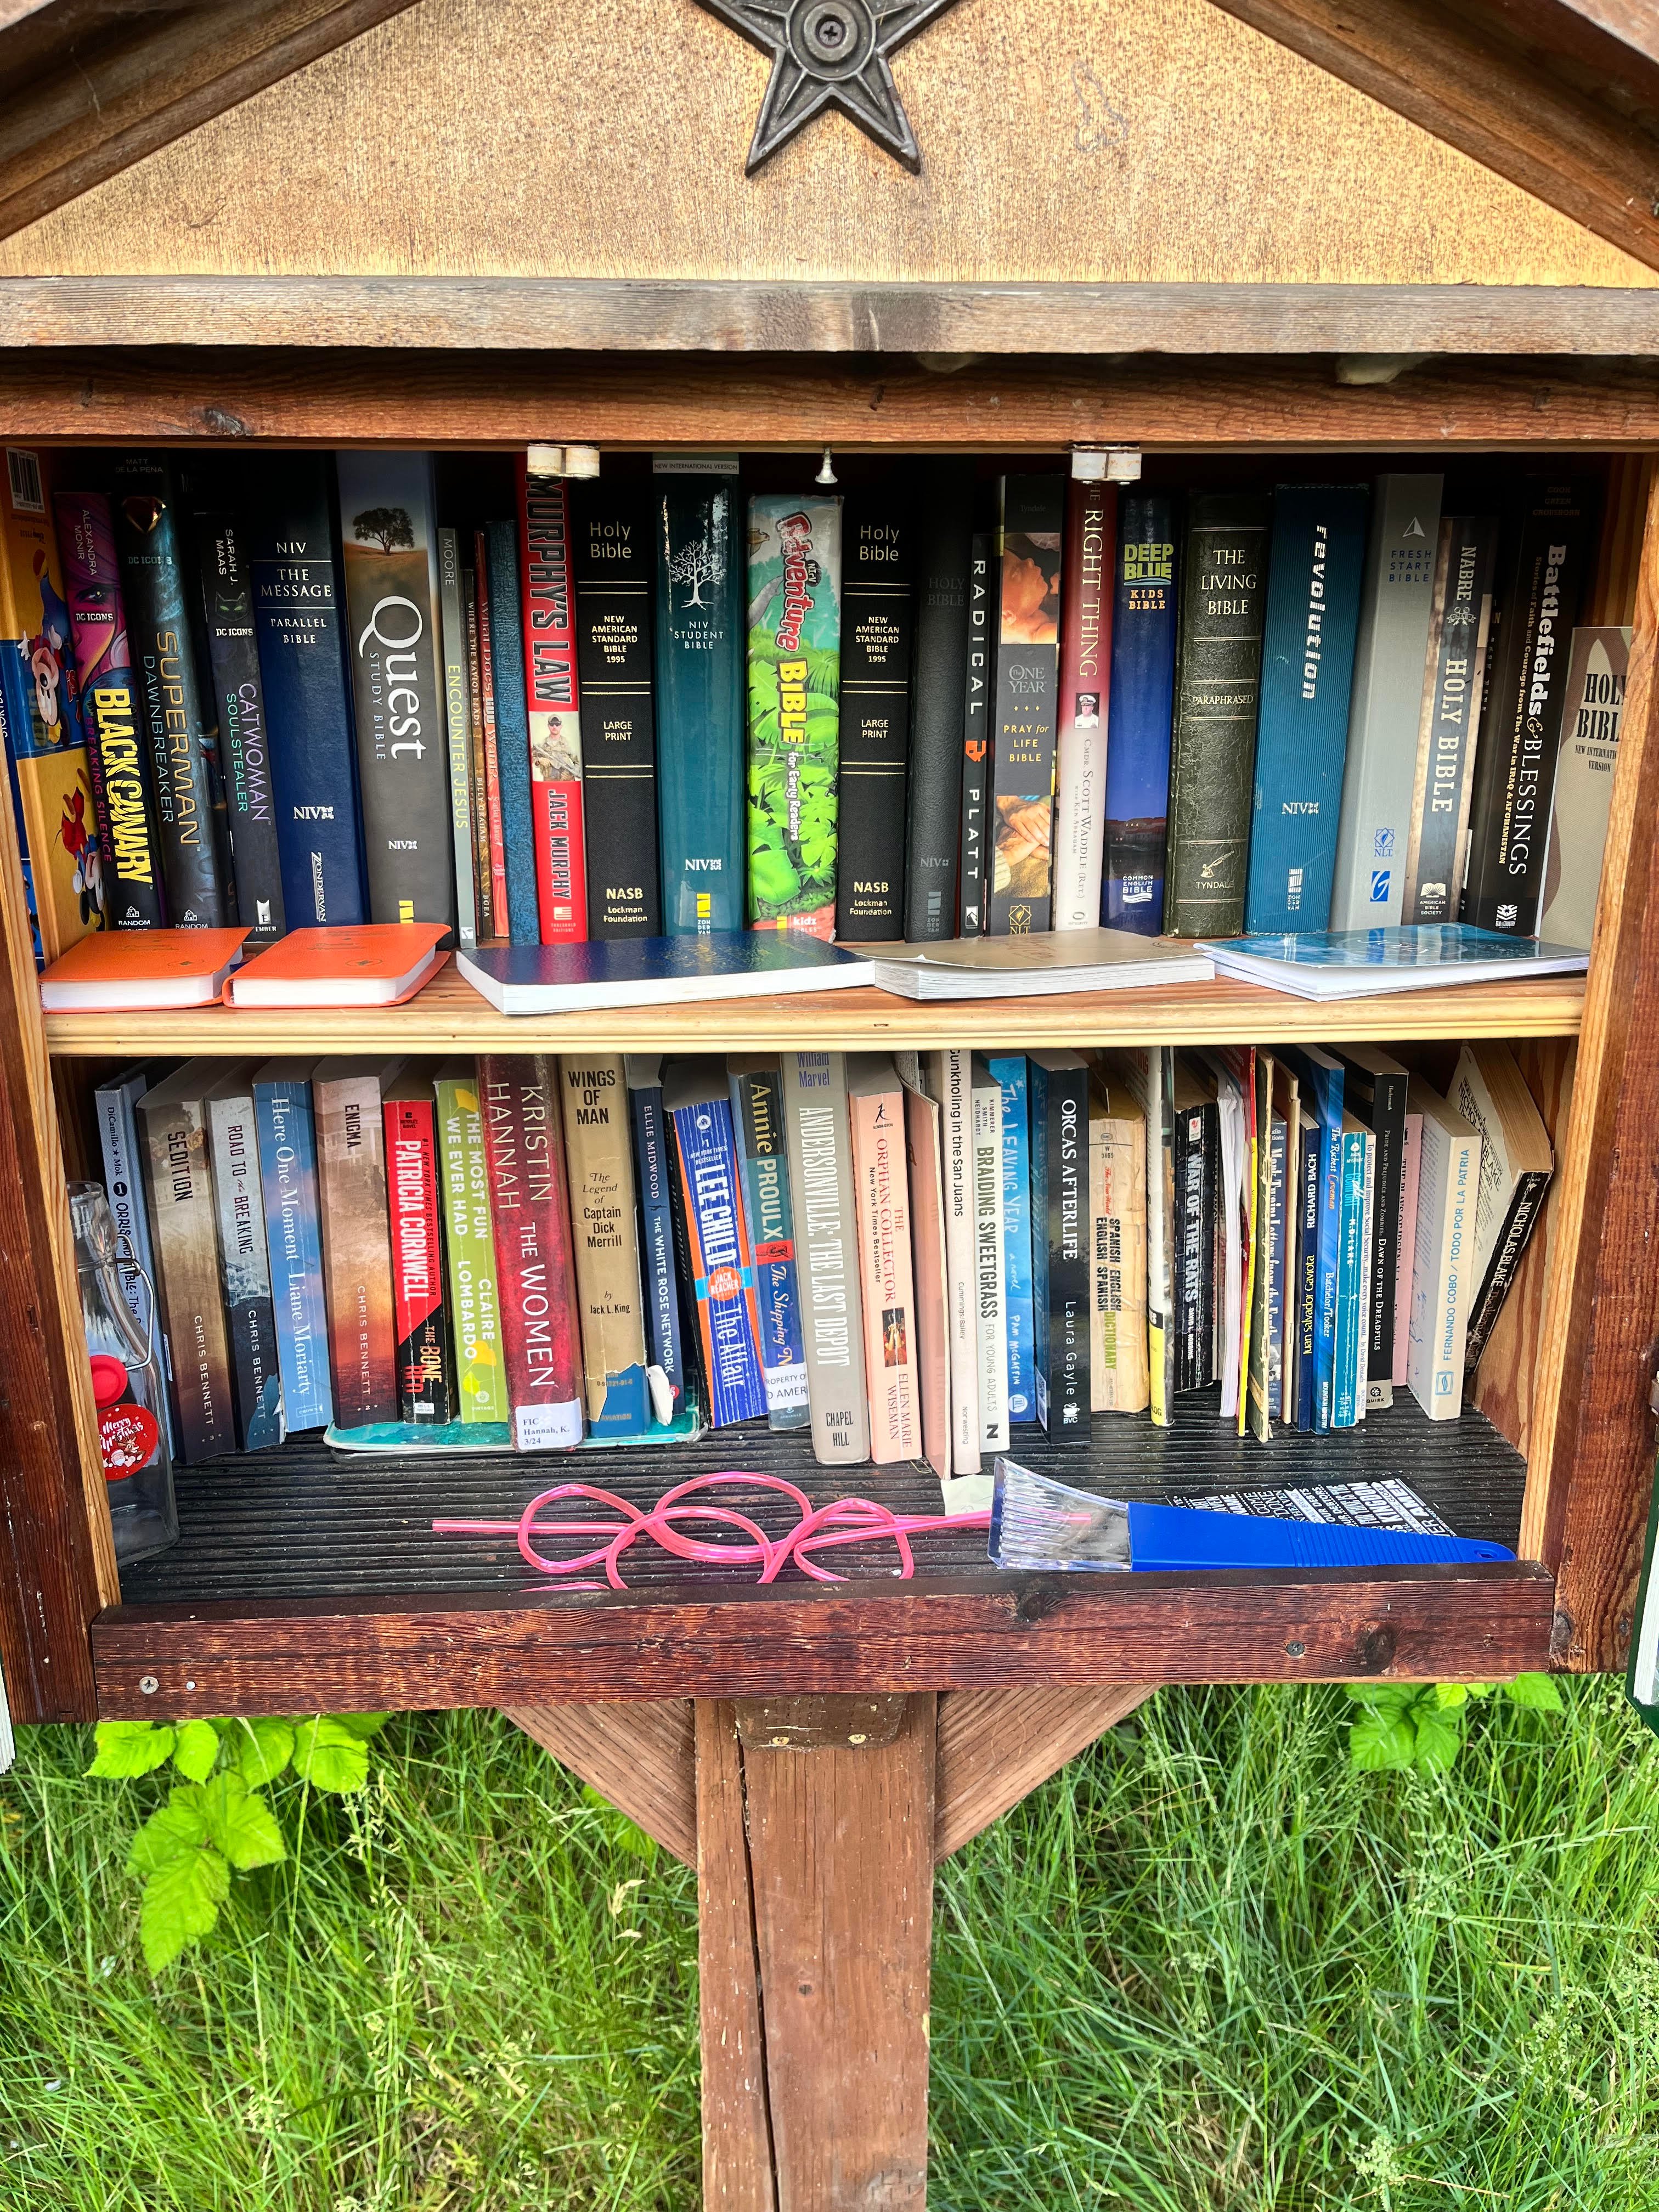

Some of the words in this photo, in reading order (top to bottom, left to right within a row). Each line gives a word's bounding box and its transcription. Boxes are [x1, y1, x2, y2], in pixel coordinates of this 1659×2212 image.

[75, 525, 84, 560] MONIR
[82, 509, 97, 575] ALEXANDRA
[216, 540, 227, 574] MAAS
[225, 529, 236, 573] SARAH
[444, 539, 454, 585] MOORE
[526, 474, 568, 629] MURPHY'S
[1082, 509, 1103, 590] RIGHT
[1125, 544, 1173, 562] DEEP
[1391, 550, 1431, 558] FRESH
[230, 576, 238, 585] J.
[261, 585, 331, 597] MESSAGE
[1124, 563, 1171, 580] BLUE
[1201, 574, 1256, 590] LIVING
[1457, 546, 1477, 601] NABRE
[1131, 590, 1163, 598] KIDS
[1303, 525, 1328, 699] revolution
[271, 618, 327, 628] PARALLEL
[970, 560, 985, 715] RADICAL
[1080, 598, 1100, 677] THING
[1528, 545, 1566, 715] Battlefields
[359, 596, 426, 759] Quest
[370, 652, 382, 706] STUDY
[533, 641, 572, 703] LAW
[1441, 659, 1468, 724] HOLY
[448, 665, 465, 772] ENCOUNTER
[1193, 695, 1253, 705] PARAPHRASED
[95, 689, 140, 777] BLACK
[144, 656, 173, 822] DAWNBREAKER
[157, 633, 200, 845] SUPERMAN
[374, 715, 386, 759] BIBLE
[603, 721, 632, 730] LARGE
[605, 732, 631, 741] PRINT
[1526, 718, 1543, 738] &
[227, 694, 248, 812] SOULSTEALER
[239, 684, 270, 821] CATWOMAN
[1432, 736, 1458, 812] BIBLE
[85, 718, 103, 794] BREAKING
[97, 802, 111, 861] SILENCE
[454, 778, 467, 828] JESUS
[549, 789, 568, 831] JACK
[1509, 740, 1542, 875] BLESSINGS
[107, 779, 153, 883] CANARY
[478, 806, 486, 843] GRAHAM
[968, 789, 980, 879] PLATT
[551, 838, 570, 899] MURPHY
[1196, 881, 1234, 889] TYNDALE
[606, 888, 642, 899] NASB
[793, 916, 817, 926] kidz
[568, 1070, 615, 1087] WINGS
[272, 1097, 290, 1142] Here
[345, 1104, 361, 1148] ENIGMA
[447, 1118, 461, 1144] WE
[467, 1112, 480, 1143] THE
[577, 1108, 608, 1125] MAN
[644, 1105, 653, 1137] ELLIE
[750, 1084, 777, 1153] Annie
[1062, 1099, 1076, 1160] ORCAS
[488, 1083, 521, 1209] HANNAH
[521, 1086, 552, 1201] KRISTIN
[168, 1131, 193, 1202] SEDITION
[276, 1147, 294, 1184] One
[395, 1141, 424, 1212] PATRICIA
[450, 1150, 465, 1193] EVER
[469, 1151, 484, 1199] MOST
[647, 1141, 659, 1198] MIDWOOD
[696, 1164, 728, 1206] LEE
[877, 1138, 892, 1204] ORPHAN
[977, 1147, 995, 1216] BRAIDING
[1308, 1153, 1317, 1181] BACH
[1459, 1149, 1469, 1185] PATRIA
[583, 1183, 617, 1194] Legend
[757, 1158, 784, 1241] PROULX
[1307, 1186, 1316, 1228] RICHARD
[1457, 1191, 1465, 1204] LA
[280, 1188, 300, 1261] Moment
[453, 1200, 467, 1235] HAD
[473, 1207, 487, 1238] FUN
[584, 1207, 621, 1221] Captain
[593, 1222, 614, 1234] Dick
[1062, 1165, 1077, 1260] AFTERLIFE
[1454, 1210, 1463, 1229] POR
[1502, 1202, 1532, 1253] NICHOLAS
[520, 1222, 538, 1257] THE
[588, 1235, 622, 1248] Merrill
[655, 1235, 666, 1275] WHITE
[699, 1205, 737, 1265] CHILD
[880, 1210, 896, 1302] COLLECTOR
[1096, 1217, 1107, 1259] ENGLISH
[1109, 1219, 1120, 1262] SPANISH
[1378, 1238, 1386, 1264] DAWN
[1451, 1233, 1462, 1261] TODO
[399, 1217, 430, 1301] CORNWELL
[979, 1222, 998, 1318] SWEETGRASS
[1305, 1255, 1314, 1291] Gaviota
[1378, 1267, 1384, 1277] OF
[1491, 1256, 1510, 1286] BLAKE
[289, 1273, 305, 1321] Liane
[457, 1261, 477, 1359] LOMBARDO
[478, 1279, 494, 1339] CLAIRE
[590, 1305, 605, 1314] Jack
[615, 1304, 630, 1314] King
[658, 1278, 669, 1310] ROSE
[1097, 1267, 1108, 1311] SPANISH
[1110, 1270, 1121, 1311] ENGLISH
[1323, 1272, 1334, 1338] Batchelor/Tooker
[1448, 1274, 1458, 1305] COBO
[521, 1265, 554, 1386] WOMEN
[984, 1324, 994, 1340] FOR
[1010, 1315, 1020, 1336] PAM
[1065, 1301, 1076, 1344] Laura
[1302, 1294, 1313, 1329] Salvador
[1374, 1301, 1384, 1350] DREADFULS
[194, 1316, 207, 1357] CHRIS
[661, 1314, 675, 1374] NETWORK
[1104, 1312, 1116, 1370] DICTIONARY
[1303, 1331, 1312, 1354] Juan
[1443, 1307, 1455, 1361] FERNANDO
[292, 1323, 310, 1395] Moriarty
[985, 1344, 995, 1374] YOUNG
[1009, 1341, 1020, 1384] McGAFFIN
[1066, 1353, 1077, 1396] Gayle
[200, 1363, 214, 1425] BENNETT
[888, 1385, 899, 1440] WISEMAN
[899, 1374, 909, 1412] ELLEN
[988, 1378, 997, 1411] ADULTS
[524, 1427, 558, 1436] Hannah,
[901, 1414, 912, 1448] MARIE
[1381, 1480, 1429, 1516] AMEN
